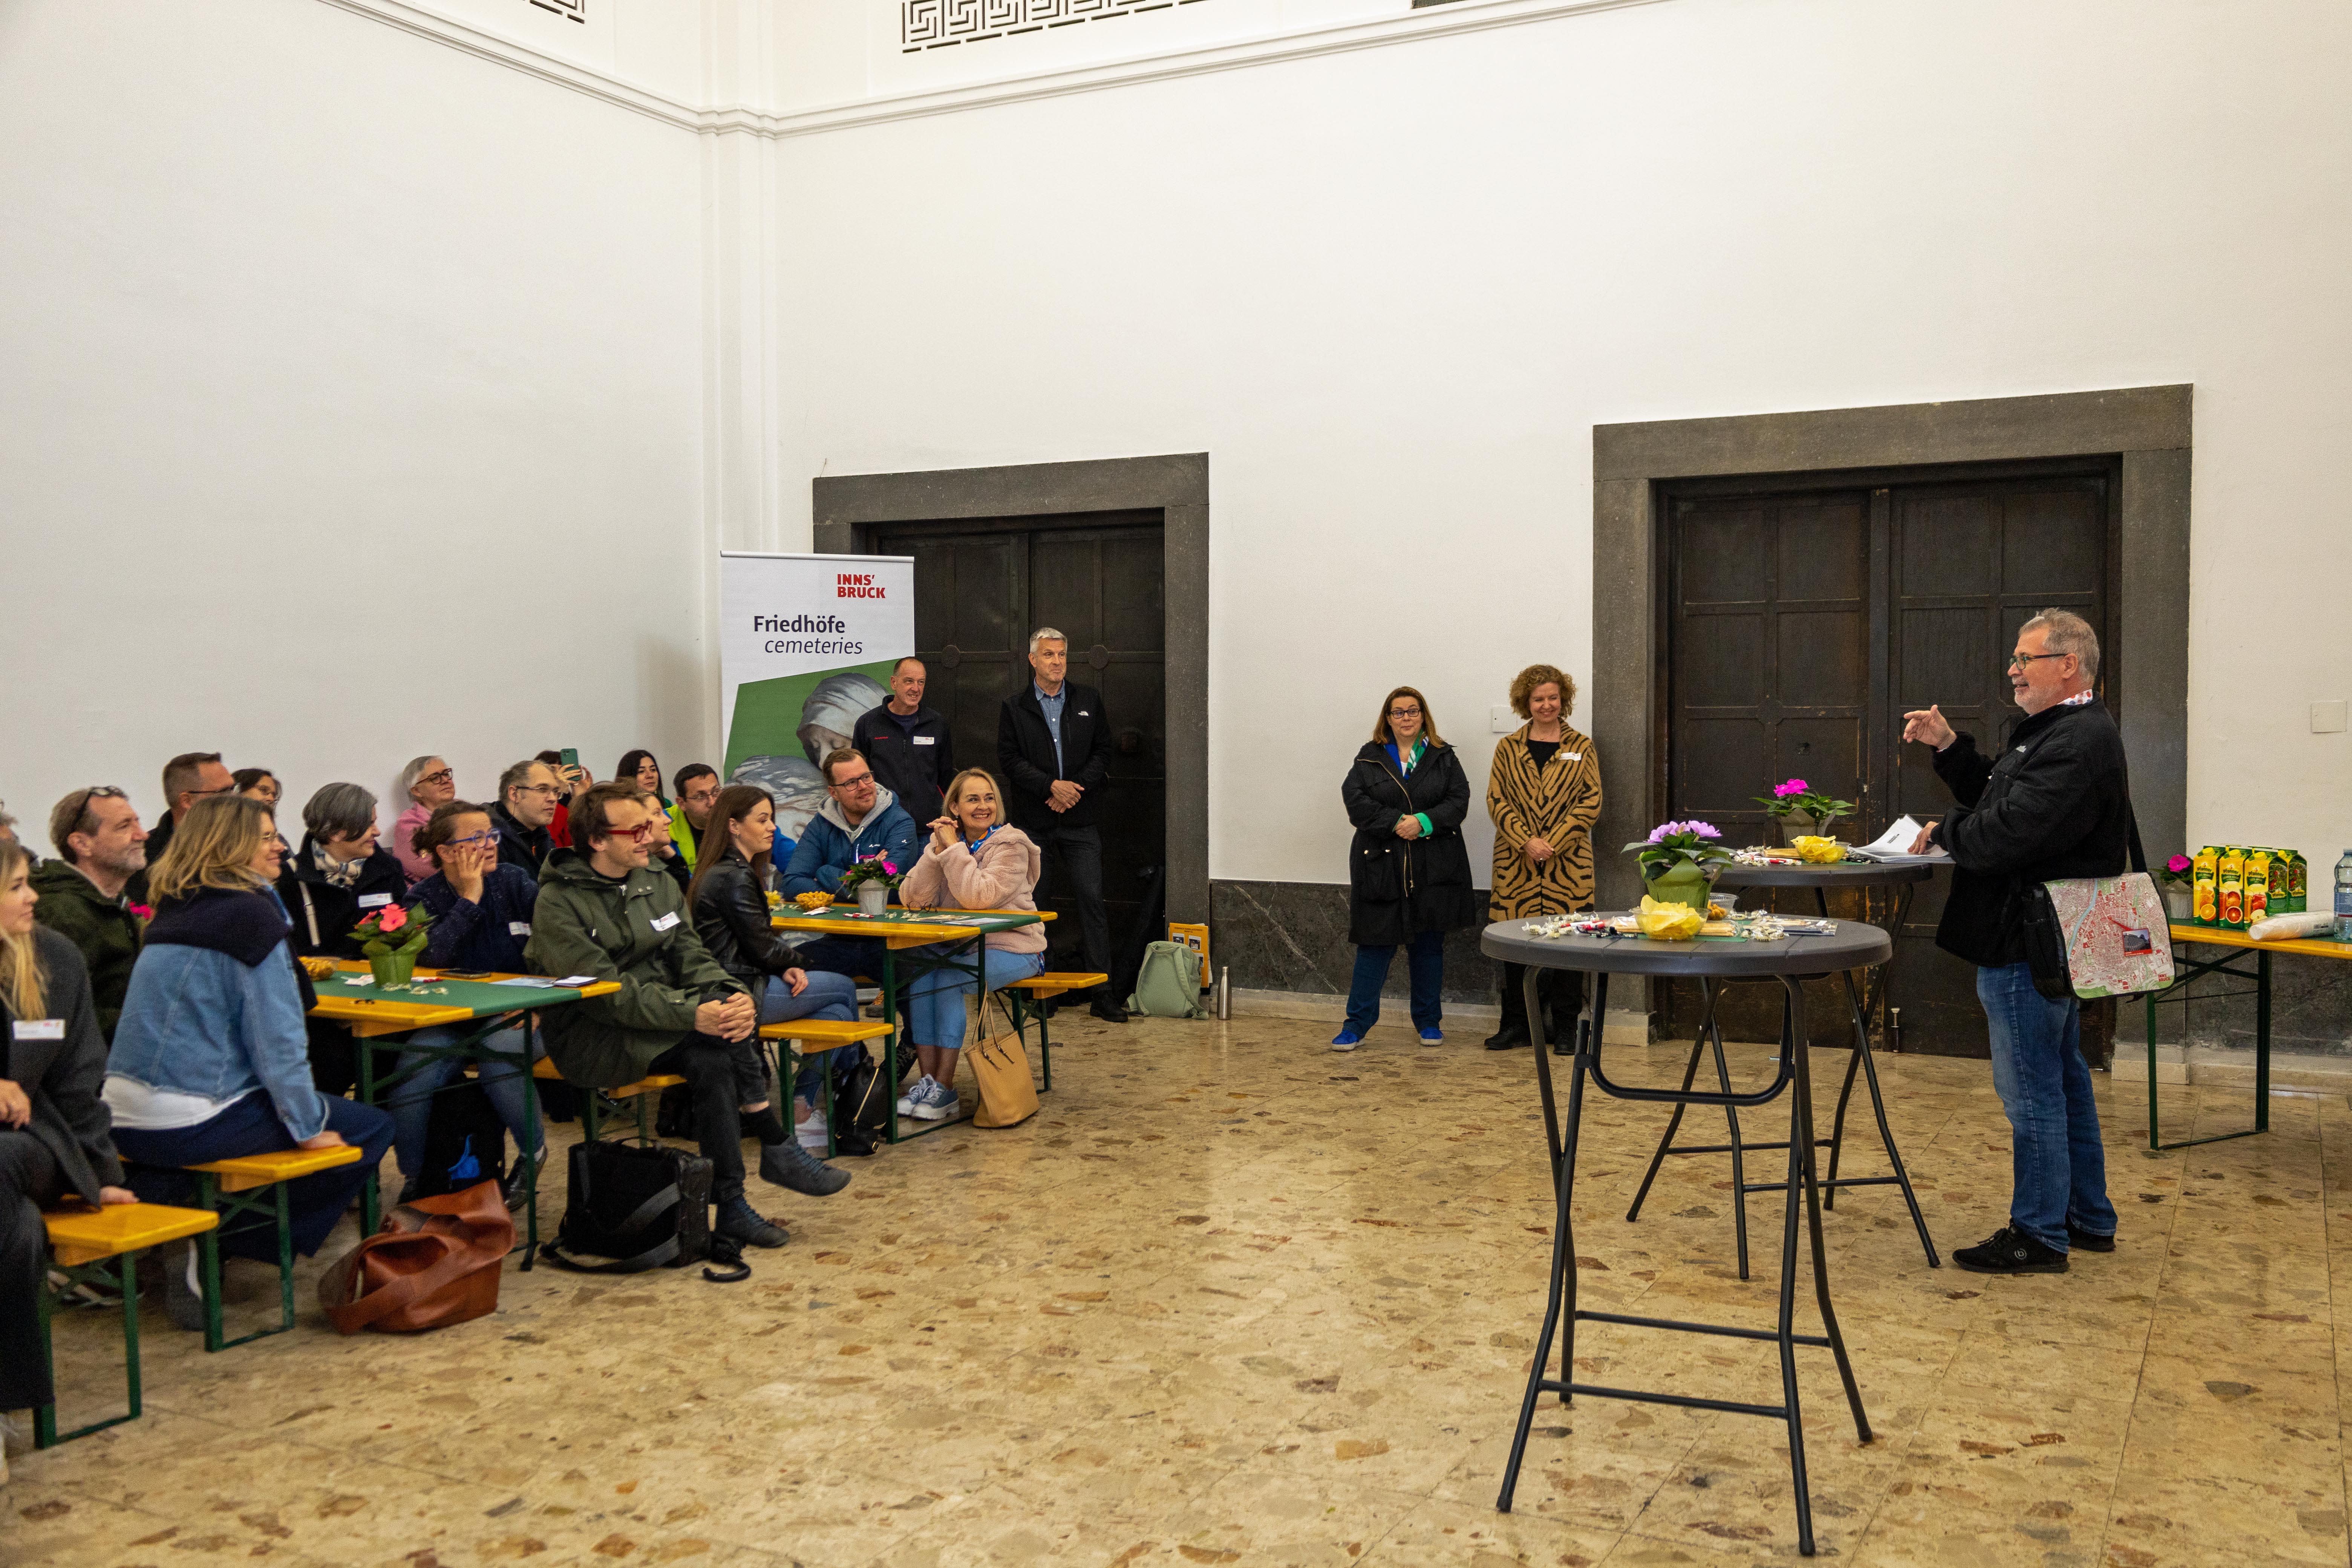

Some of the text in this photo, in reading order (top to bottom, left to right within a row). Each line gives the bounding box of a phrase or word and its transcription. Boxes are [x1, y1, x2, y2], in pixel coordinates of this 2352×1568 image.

[837, 574, 875, 585] INNS'
[837, 587, 886, 599] BRUCK
[754, 614, 845, 633] Friedhöfe
[765, 637, 862, 654] cemeteries
